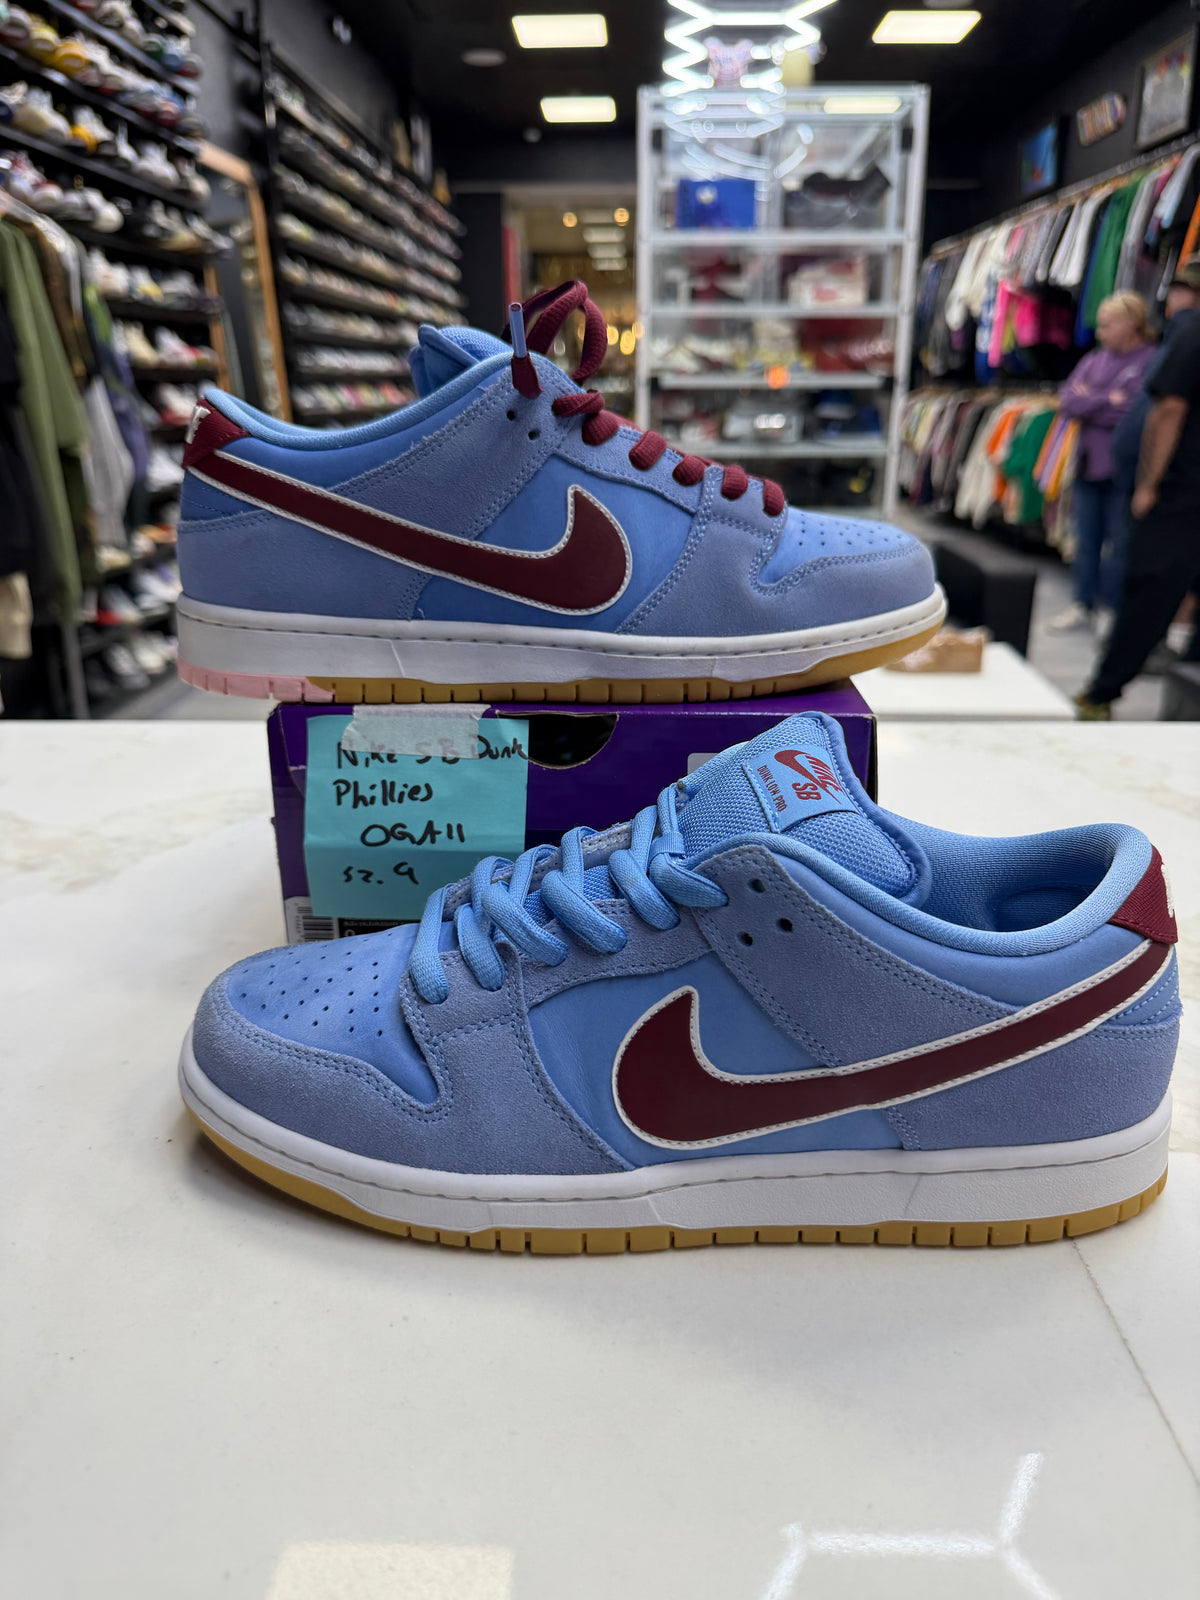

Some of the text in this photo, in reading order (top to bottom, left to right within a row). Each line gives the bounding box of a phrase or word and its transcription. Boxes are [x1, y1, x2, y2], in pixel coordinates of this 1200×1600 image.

[337, 738, 398, 769] Nike
[469, 733, 530, 761] Dunk
[332, 778, 434, 809] Phillies
[756, 764, 788, 813] DUNK LOW PRO
[791, 782, 822, 801] SB
[393, 861, 420, 886] 9
